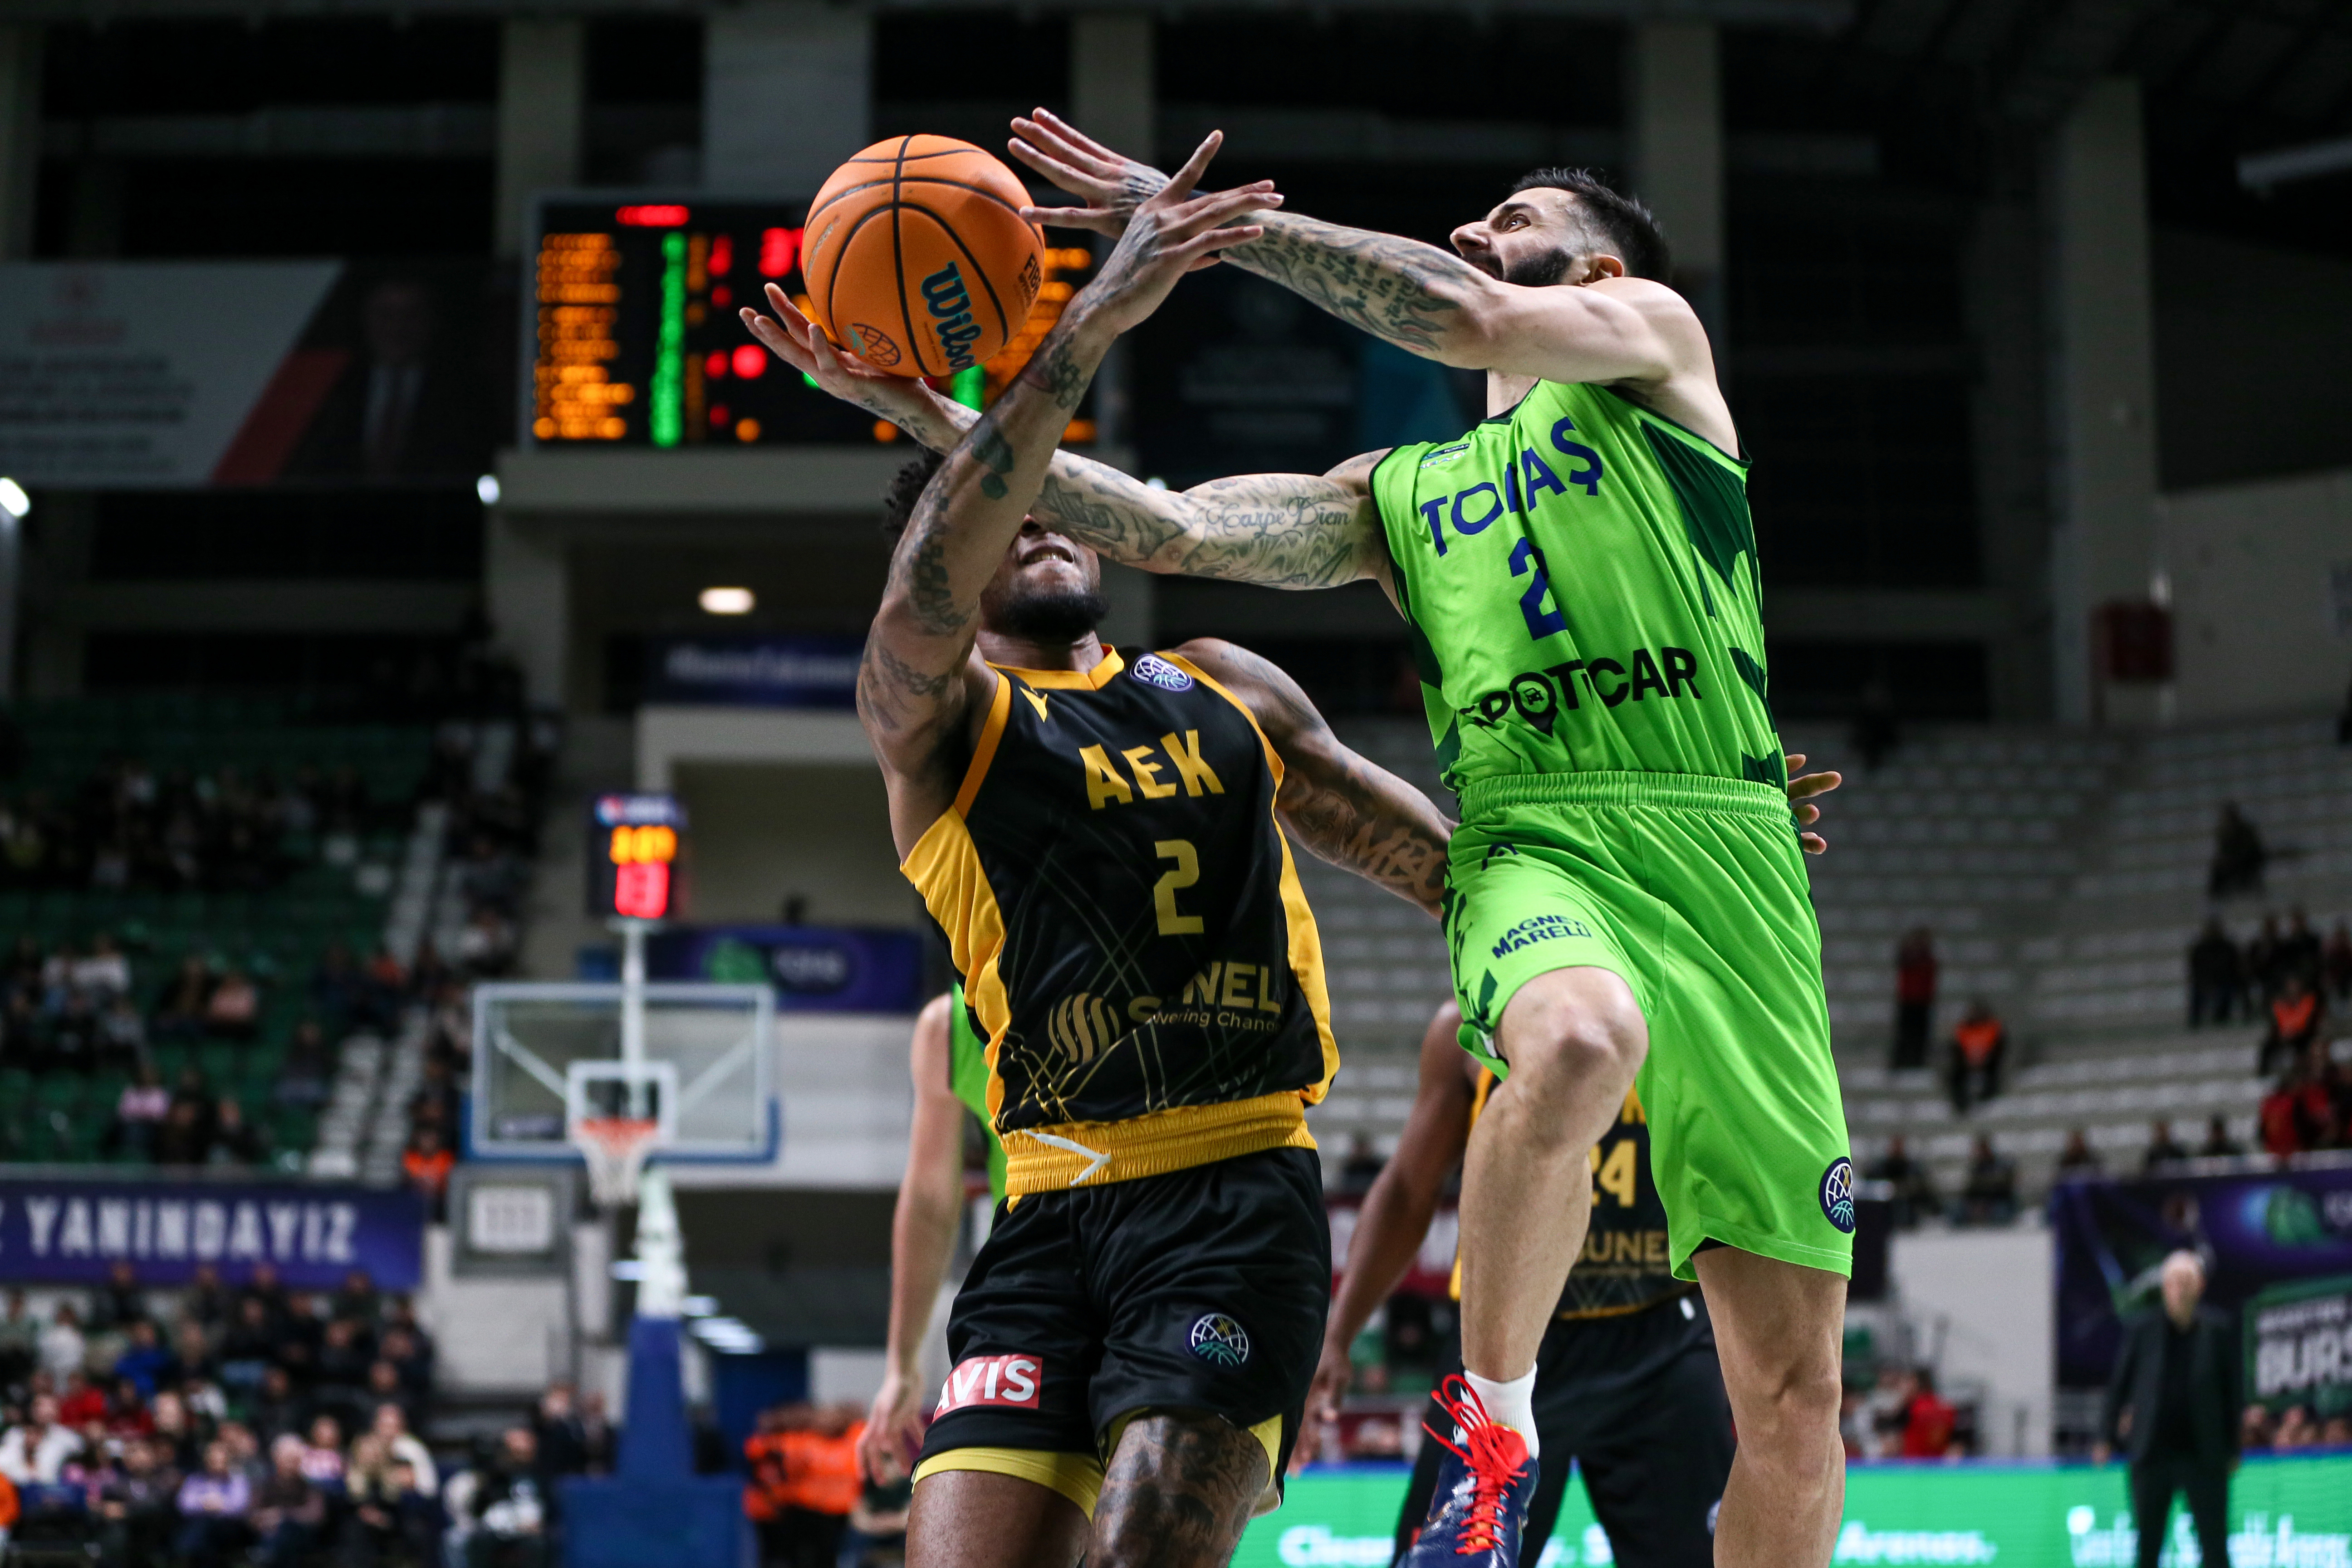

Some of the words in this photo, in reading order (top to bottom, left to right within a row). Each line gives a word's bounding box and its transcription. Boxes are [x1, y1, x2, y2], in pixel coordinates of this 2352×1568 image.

[1508, 537, 1568, 641] 2
[1079, 729, 1225, 810] AEK
[1153, 839, 1204, 936] 2
[1128, 961, 1281, 1024] SNEL
[1153, 1008, 1210, 1027] wering
[1217, 1011, 1282, 1035] Chang
[1578, 1230, 1669, 1263] UNE
[936, 1359, 1037, 1411] AVIS
